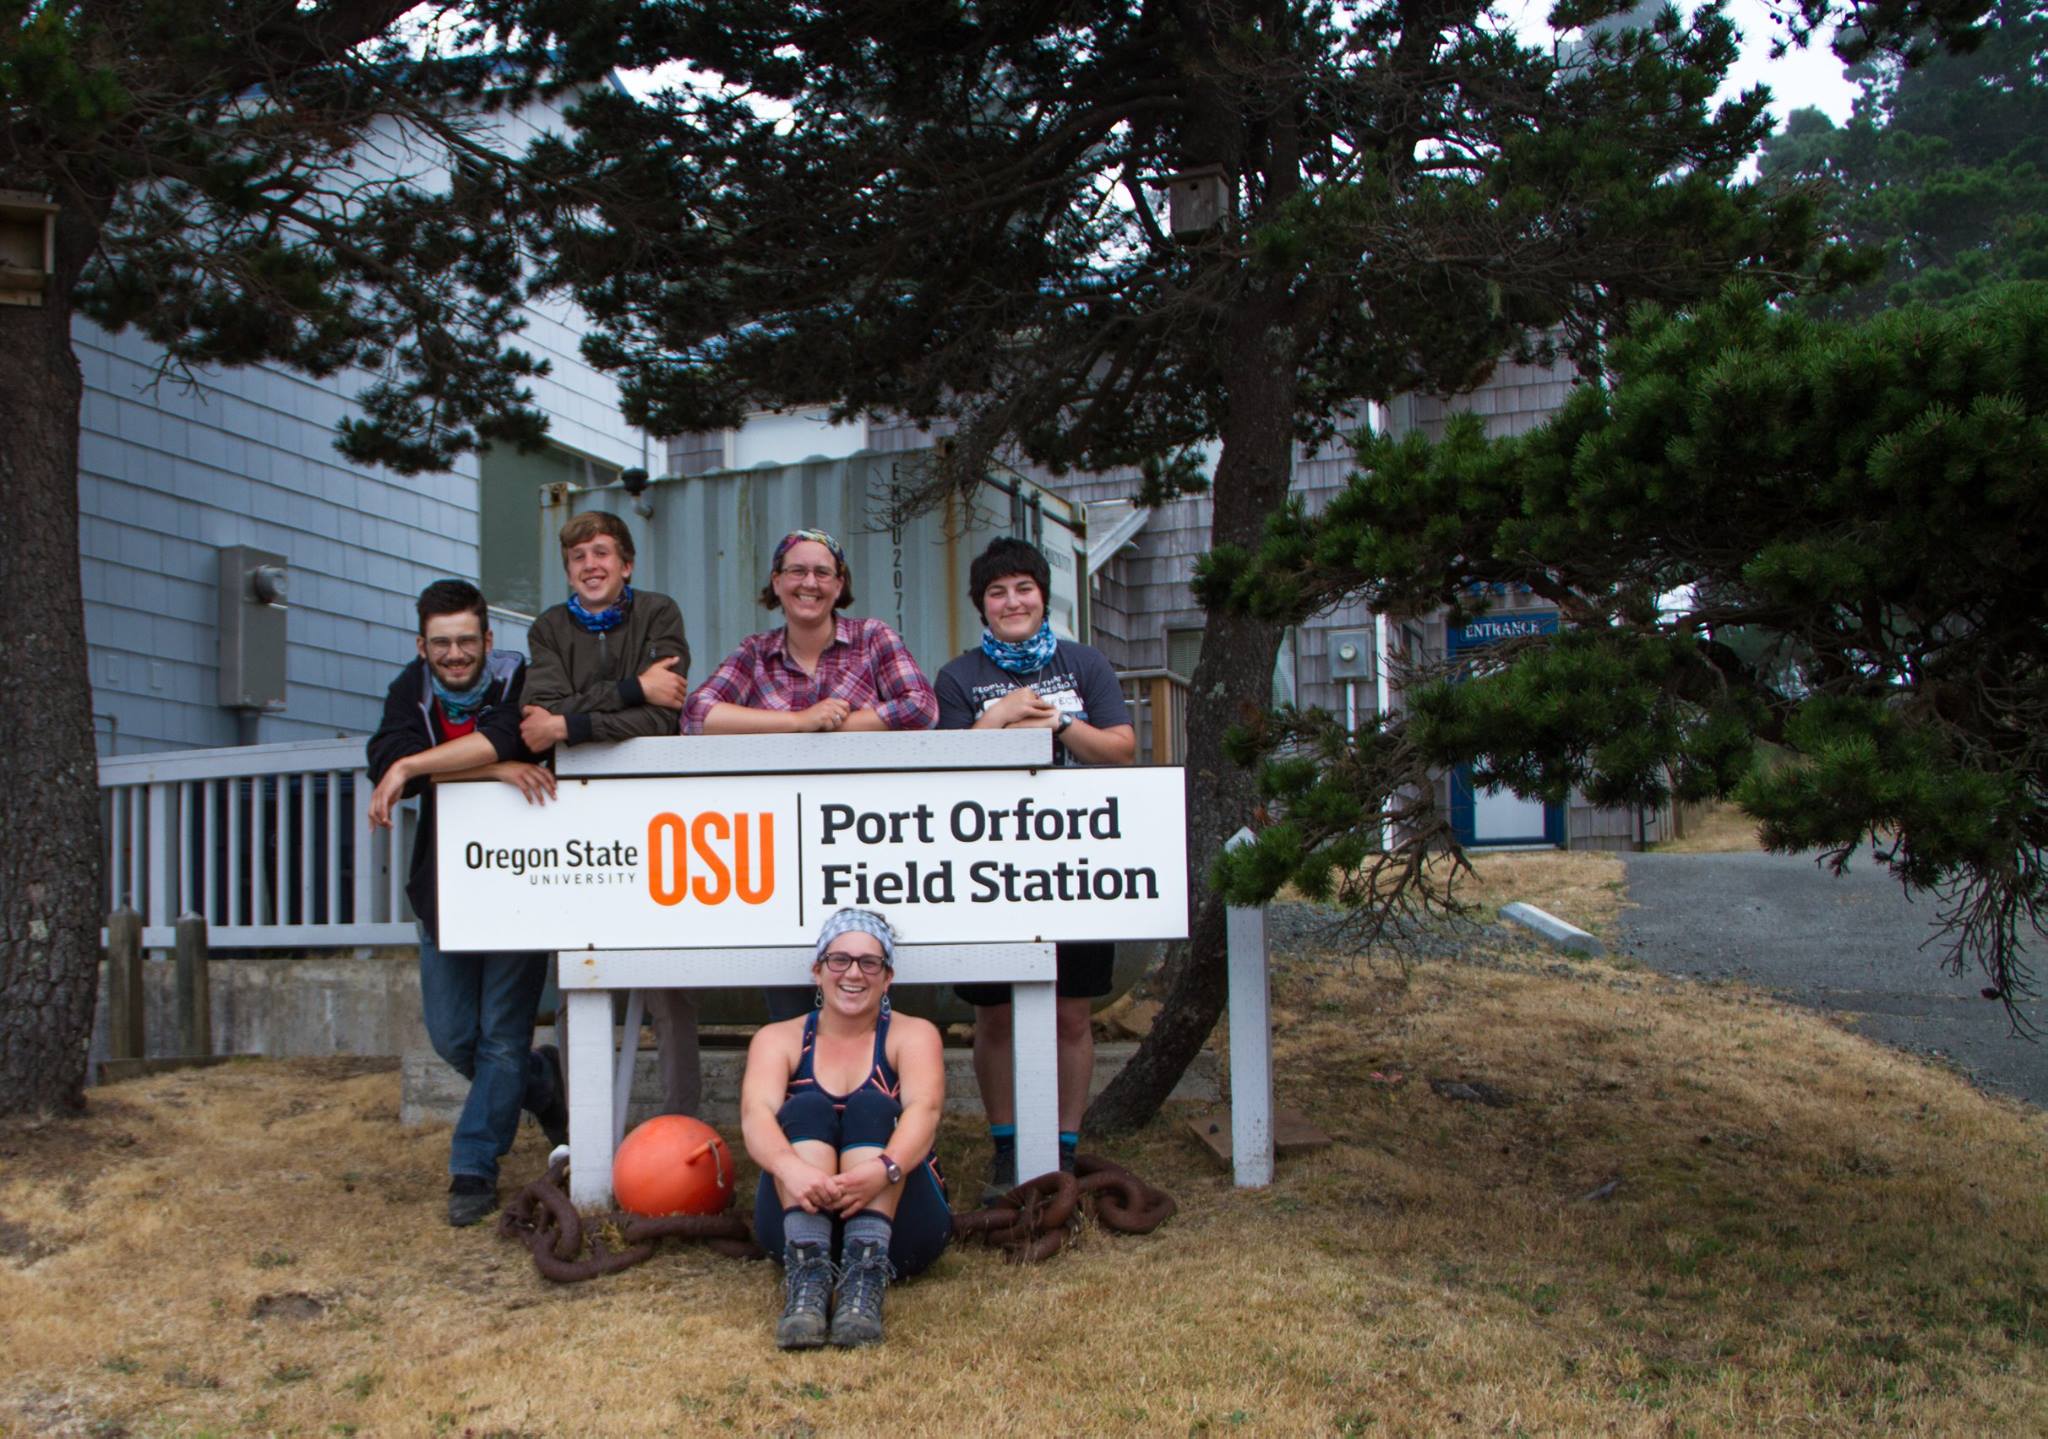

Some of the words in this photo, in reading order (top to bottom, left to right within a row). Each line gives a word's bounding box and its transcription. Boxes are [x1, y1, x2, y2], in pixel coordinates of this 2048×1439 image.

[1465, 620, 1539, 638] ENTRANCE
[820, 803, 935, 845] Port
[950, 796, 1122, 843] Orford
[465, 841, 559, 876] Oregon
[566, 839, 638, 868] State
[647, 811, 775, 907] OSU
[528, 872, 638, 886] UNIVERSITY
[821, 860, 956, 905] Field
[969, 857, 1159, 903] Station
